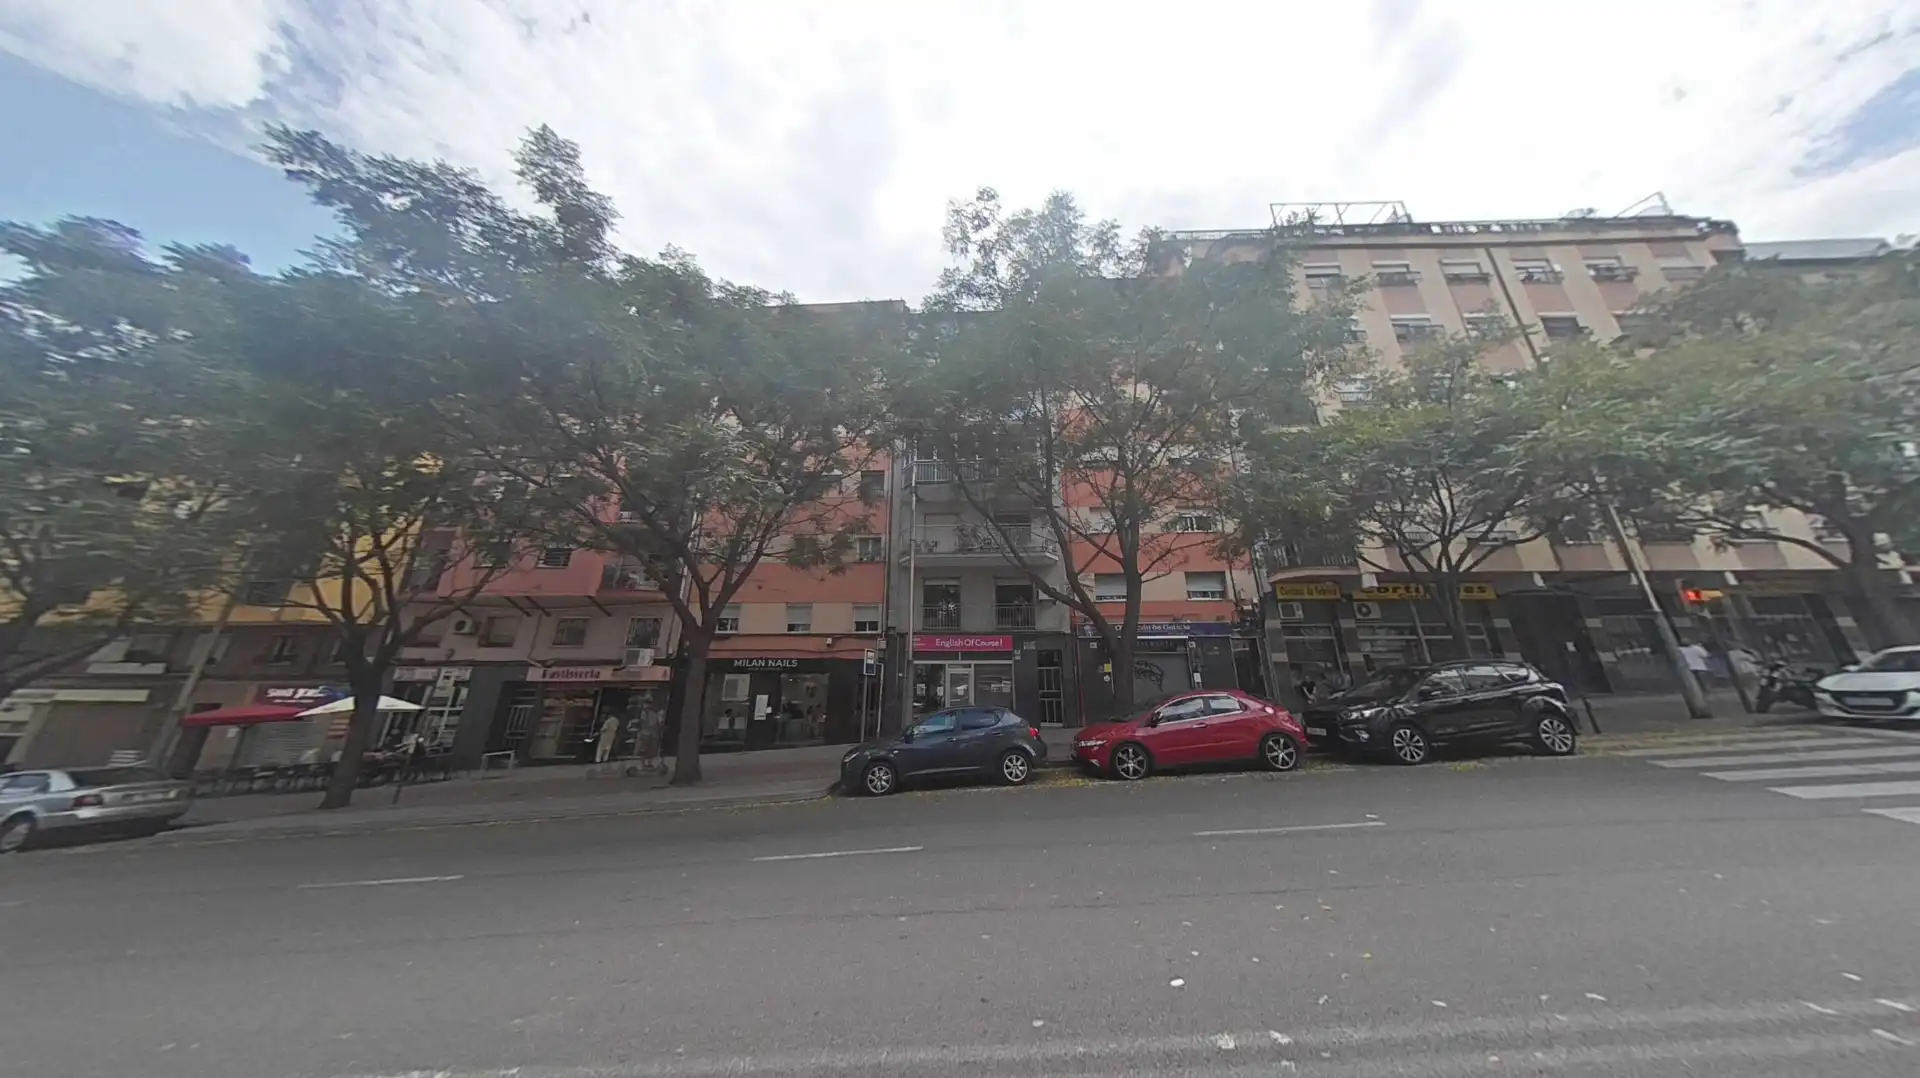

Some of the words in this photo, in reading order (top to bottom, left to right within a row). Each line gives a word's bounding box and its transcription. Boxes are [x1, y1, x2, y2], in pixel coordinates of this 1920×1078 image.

[935, 638, 963, 648] English
[964, 639, 974, 647] Of
[975, 638, 1003, 647] Course!
[734, 659, 766, 667] MILAN
[768, 659, 798, 667] NAILS
